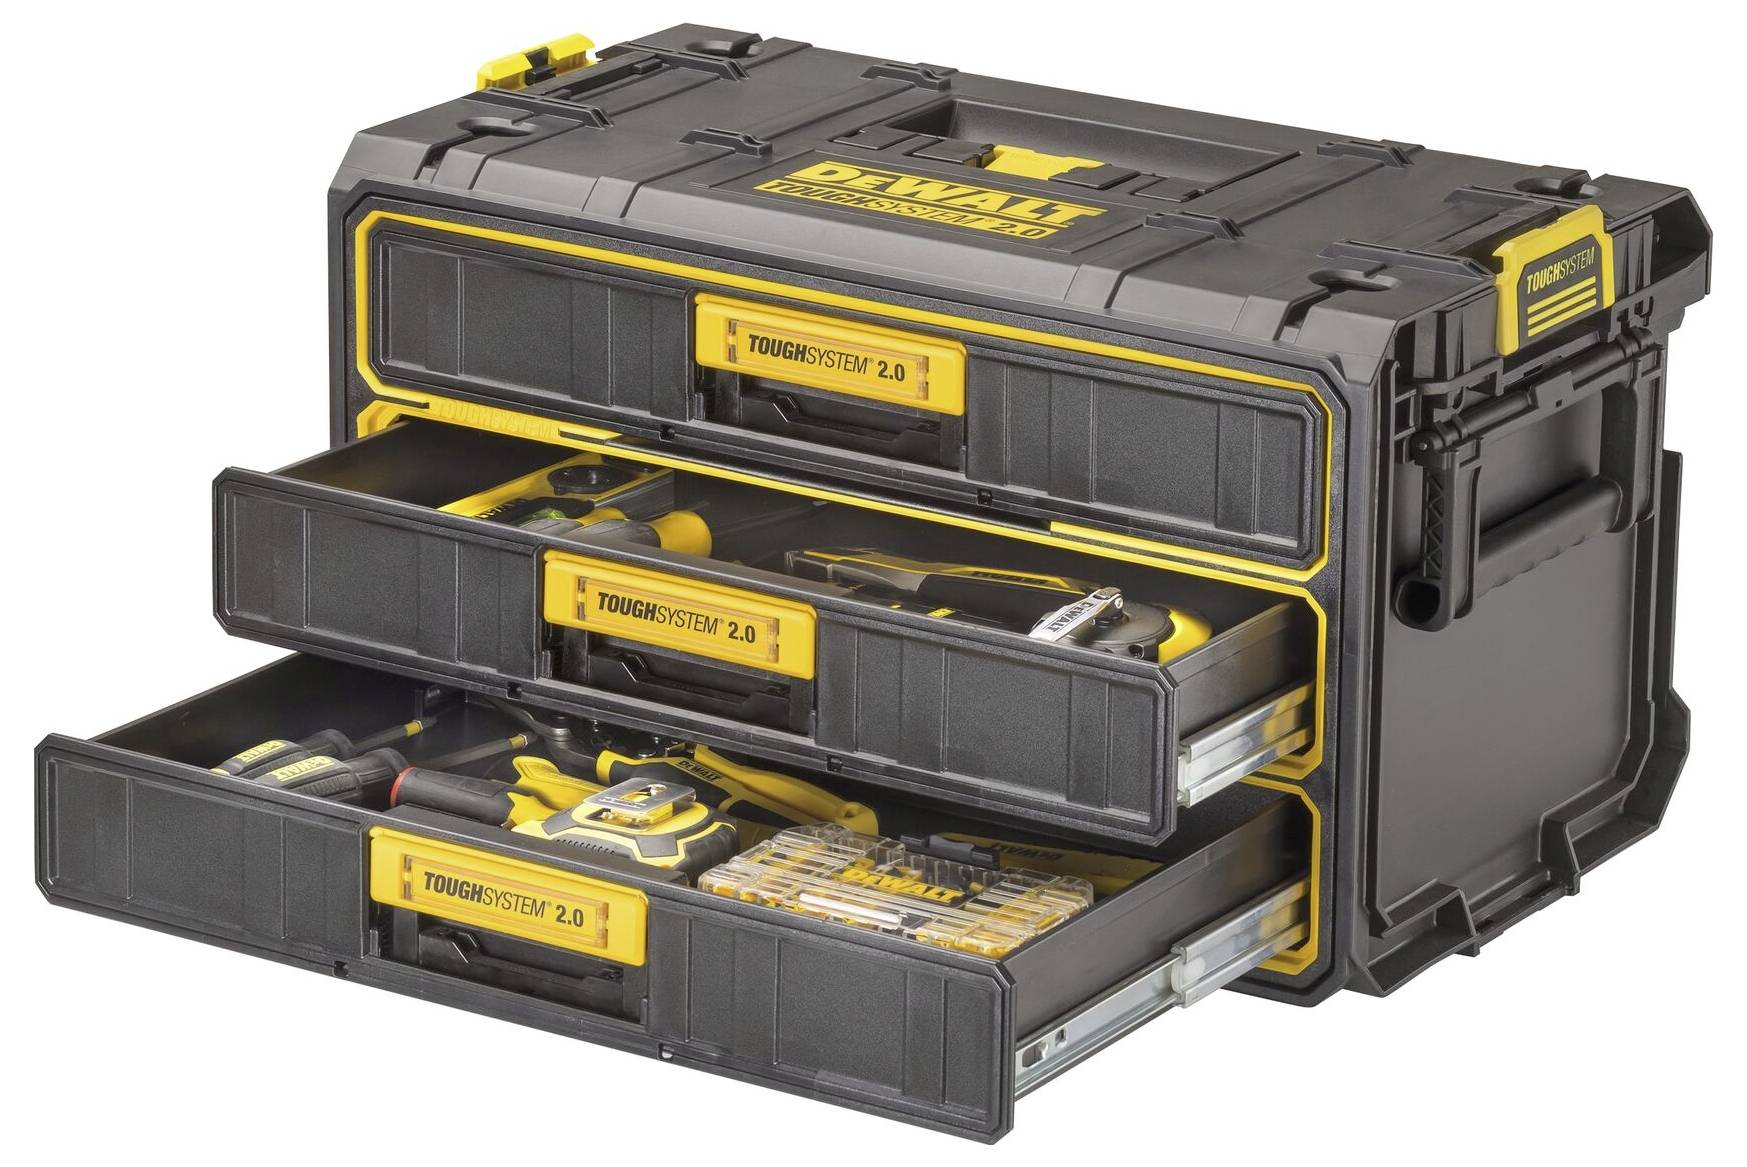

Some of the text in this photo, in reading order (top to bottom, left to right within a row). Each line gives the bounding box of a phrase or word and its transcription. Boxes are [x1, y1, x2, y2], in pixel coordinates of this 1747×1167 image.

[785, 161, 1108, 226] DEWALT
[990, 220, 1048, 239] 2.0
[1526, 246, 1595, 294] TOUGHSYSTEM
[877, 360, 905, 382] 2.0
[1046, 601, 1094, 633] DEWALT
[728, 622, 756, 643] 2.0
[840, 866, 966, 903] DEWALT
[555, 904, 585, 927] 2.0
